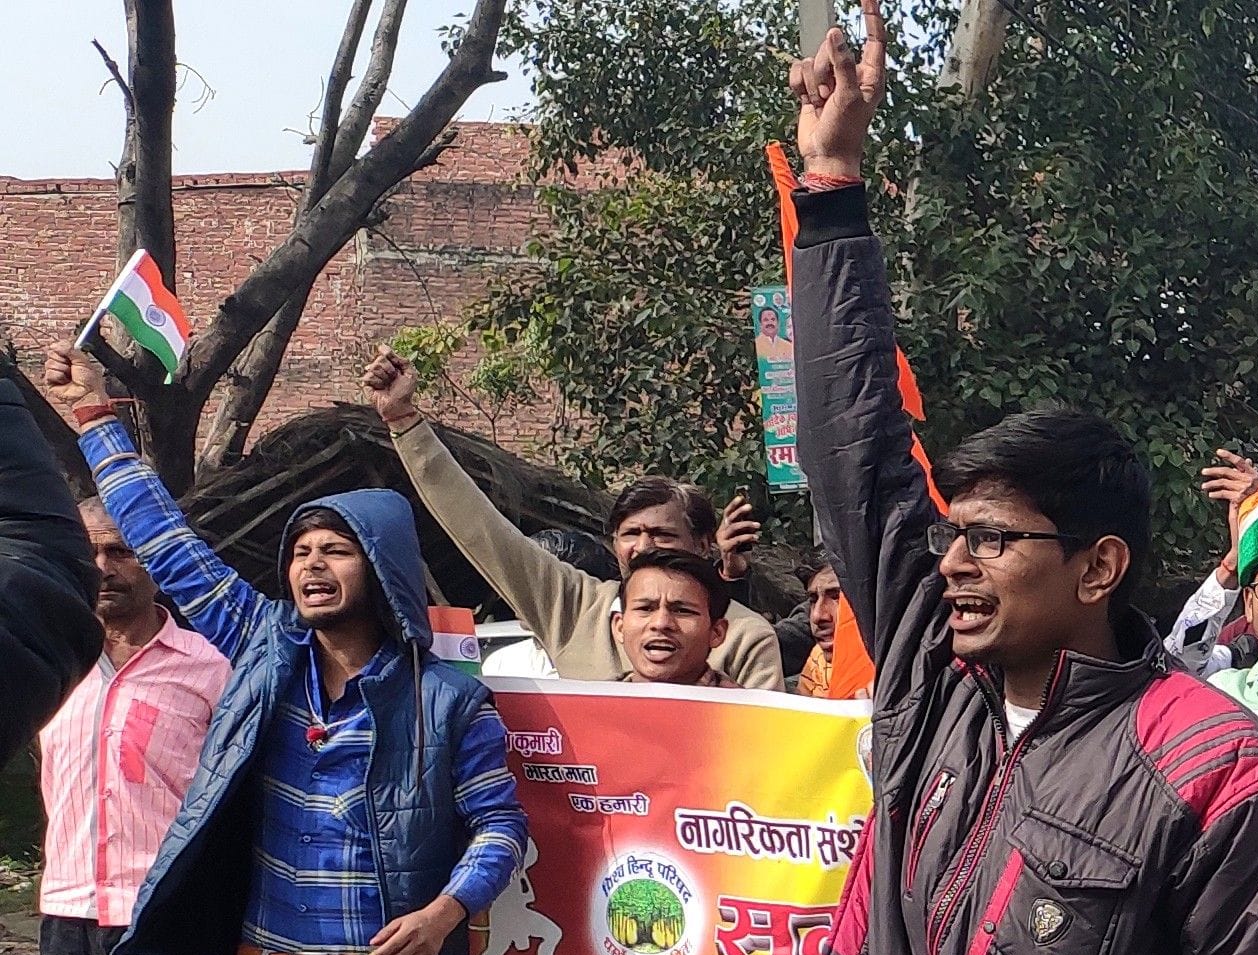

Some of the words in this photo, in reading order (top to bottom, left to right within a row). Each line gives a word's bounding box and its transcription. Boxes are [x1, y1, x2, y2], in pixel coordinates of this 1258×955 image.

[514, 729, 560, 755] कुमारी
[523, 763, 561, 782] भारत
[562, 765, 596, 783] माता
[570, 794, 594, 811] एक
[598, 793, 648, 813] हमारी
[679, 806, 811, 859] नागरिकता
